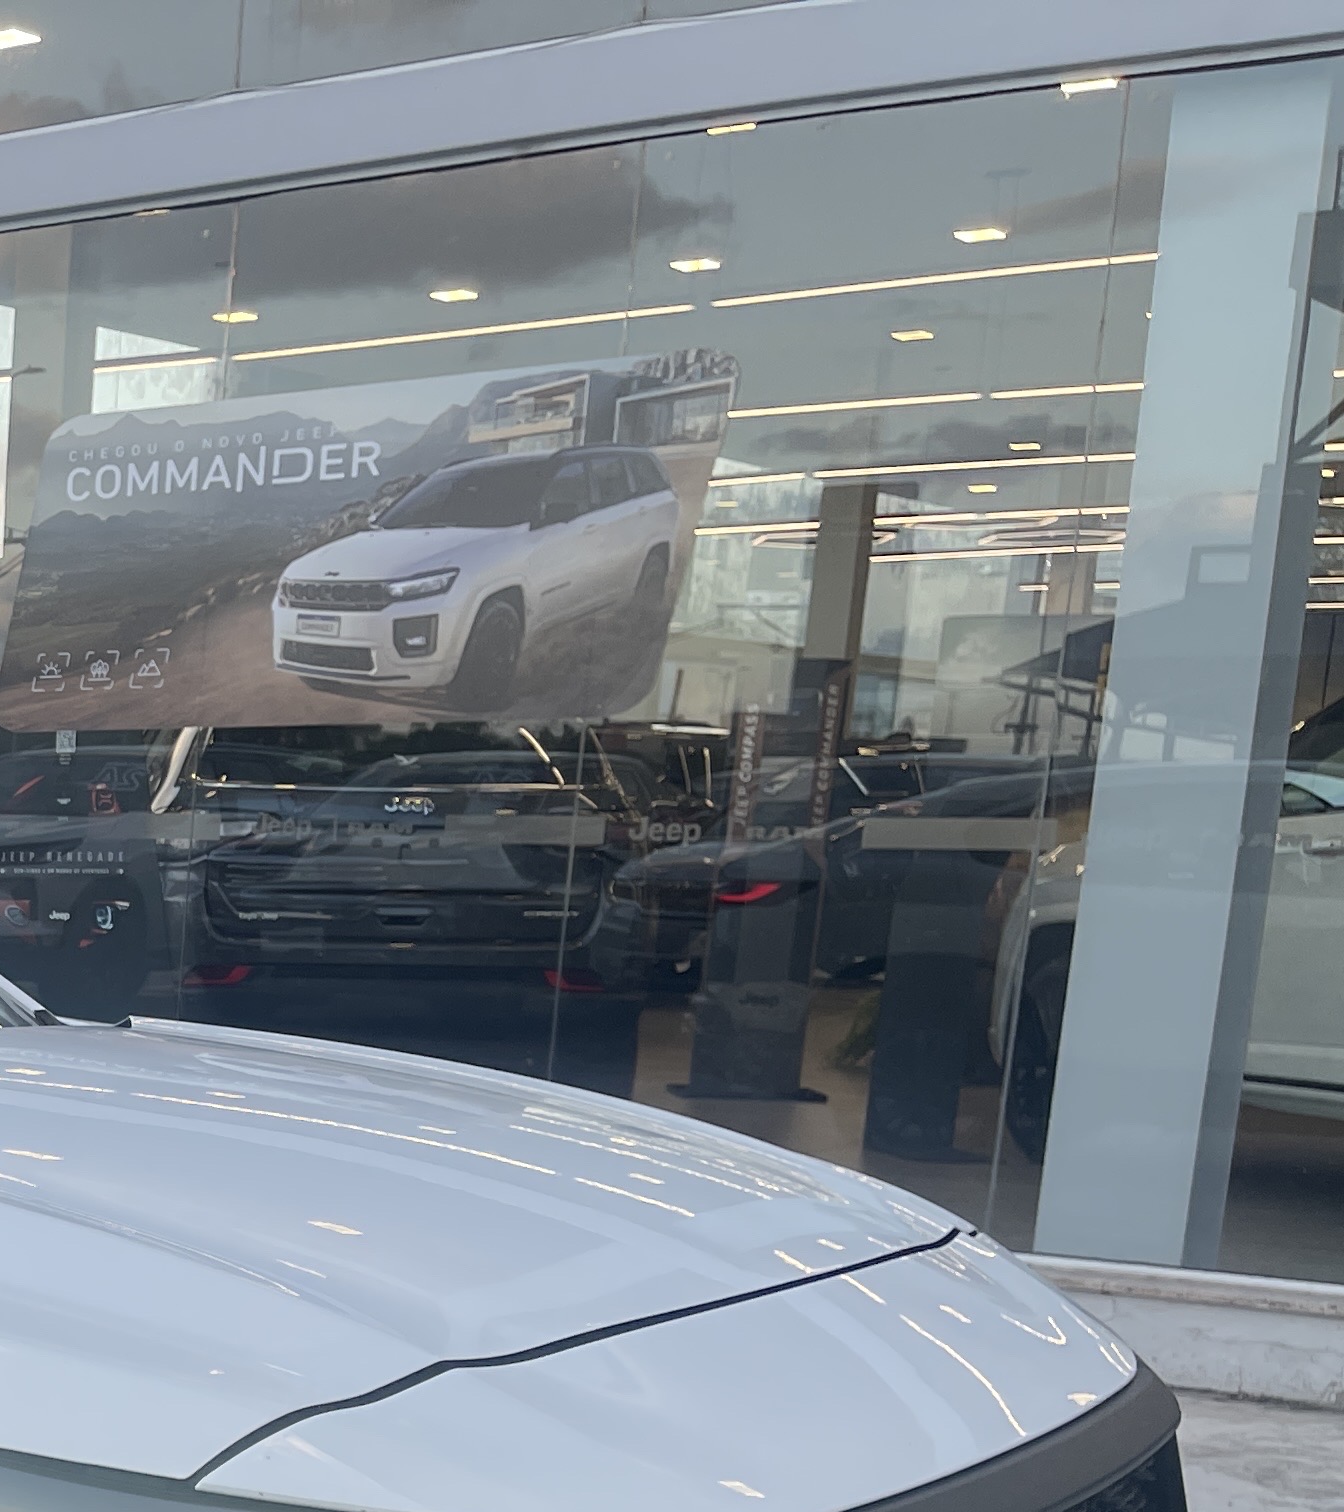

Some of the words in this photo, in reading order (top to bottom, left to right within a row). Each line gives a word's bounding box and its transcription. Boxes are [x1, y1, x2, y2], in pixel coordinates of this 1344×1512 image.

[69, 443, 158, 463] CHEGOU
[175, 439, 185, 453] O
[202, 432, 263, 450] NOVO
[66, 440, 382, 502] COMMANDER
[628, 815, 702, 847] Jeep
[1, 851, 35, 862] JEEP
